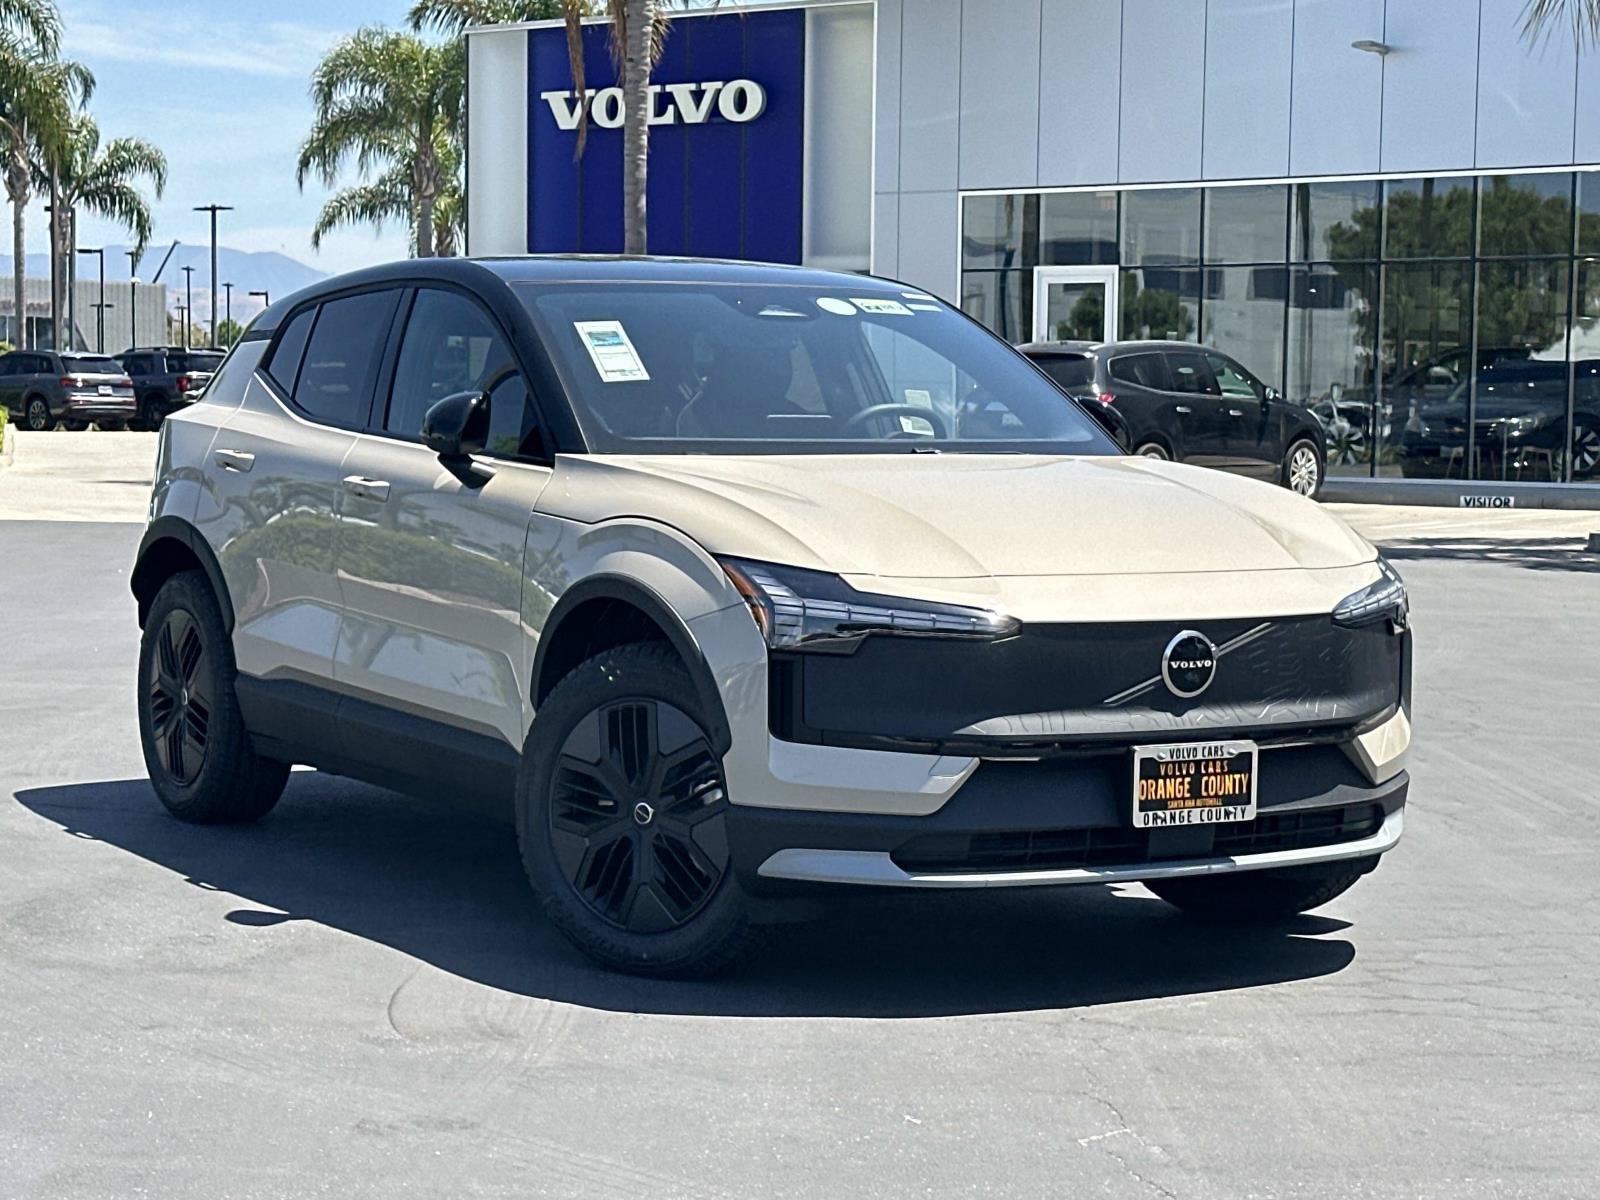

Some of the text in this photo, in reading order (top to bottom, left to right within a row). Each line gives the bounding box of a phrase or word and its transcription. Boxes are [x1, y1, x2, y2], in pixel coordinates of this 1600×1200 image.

[540, 79, 764, 130] VOLVO
[1464, 497, 1511, 508] VISITOR
[1170, 660, 1212, 669] VOLVO
[1169, 744, 1225, 760] VOLVO CARS
[1160, 759, 1228, 776] VOLVO CARS
[1139, 773, 1249, 801] ORANGE COUNTY
[1143, 806, 1247, 826] ORANGE COUNTY
